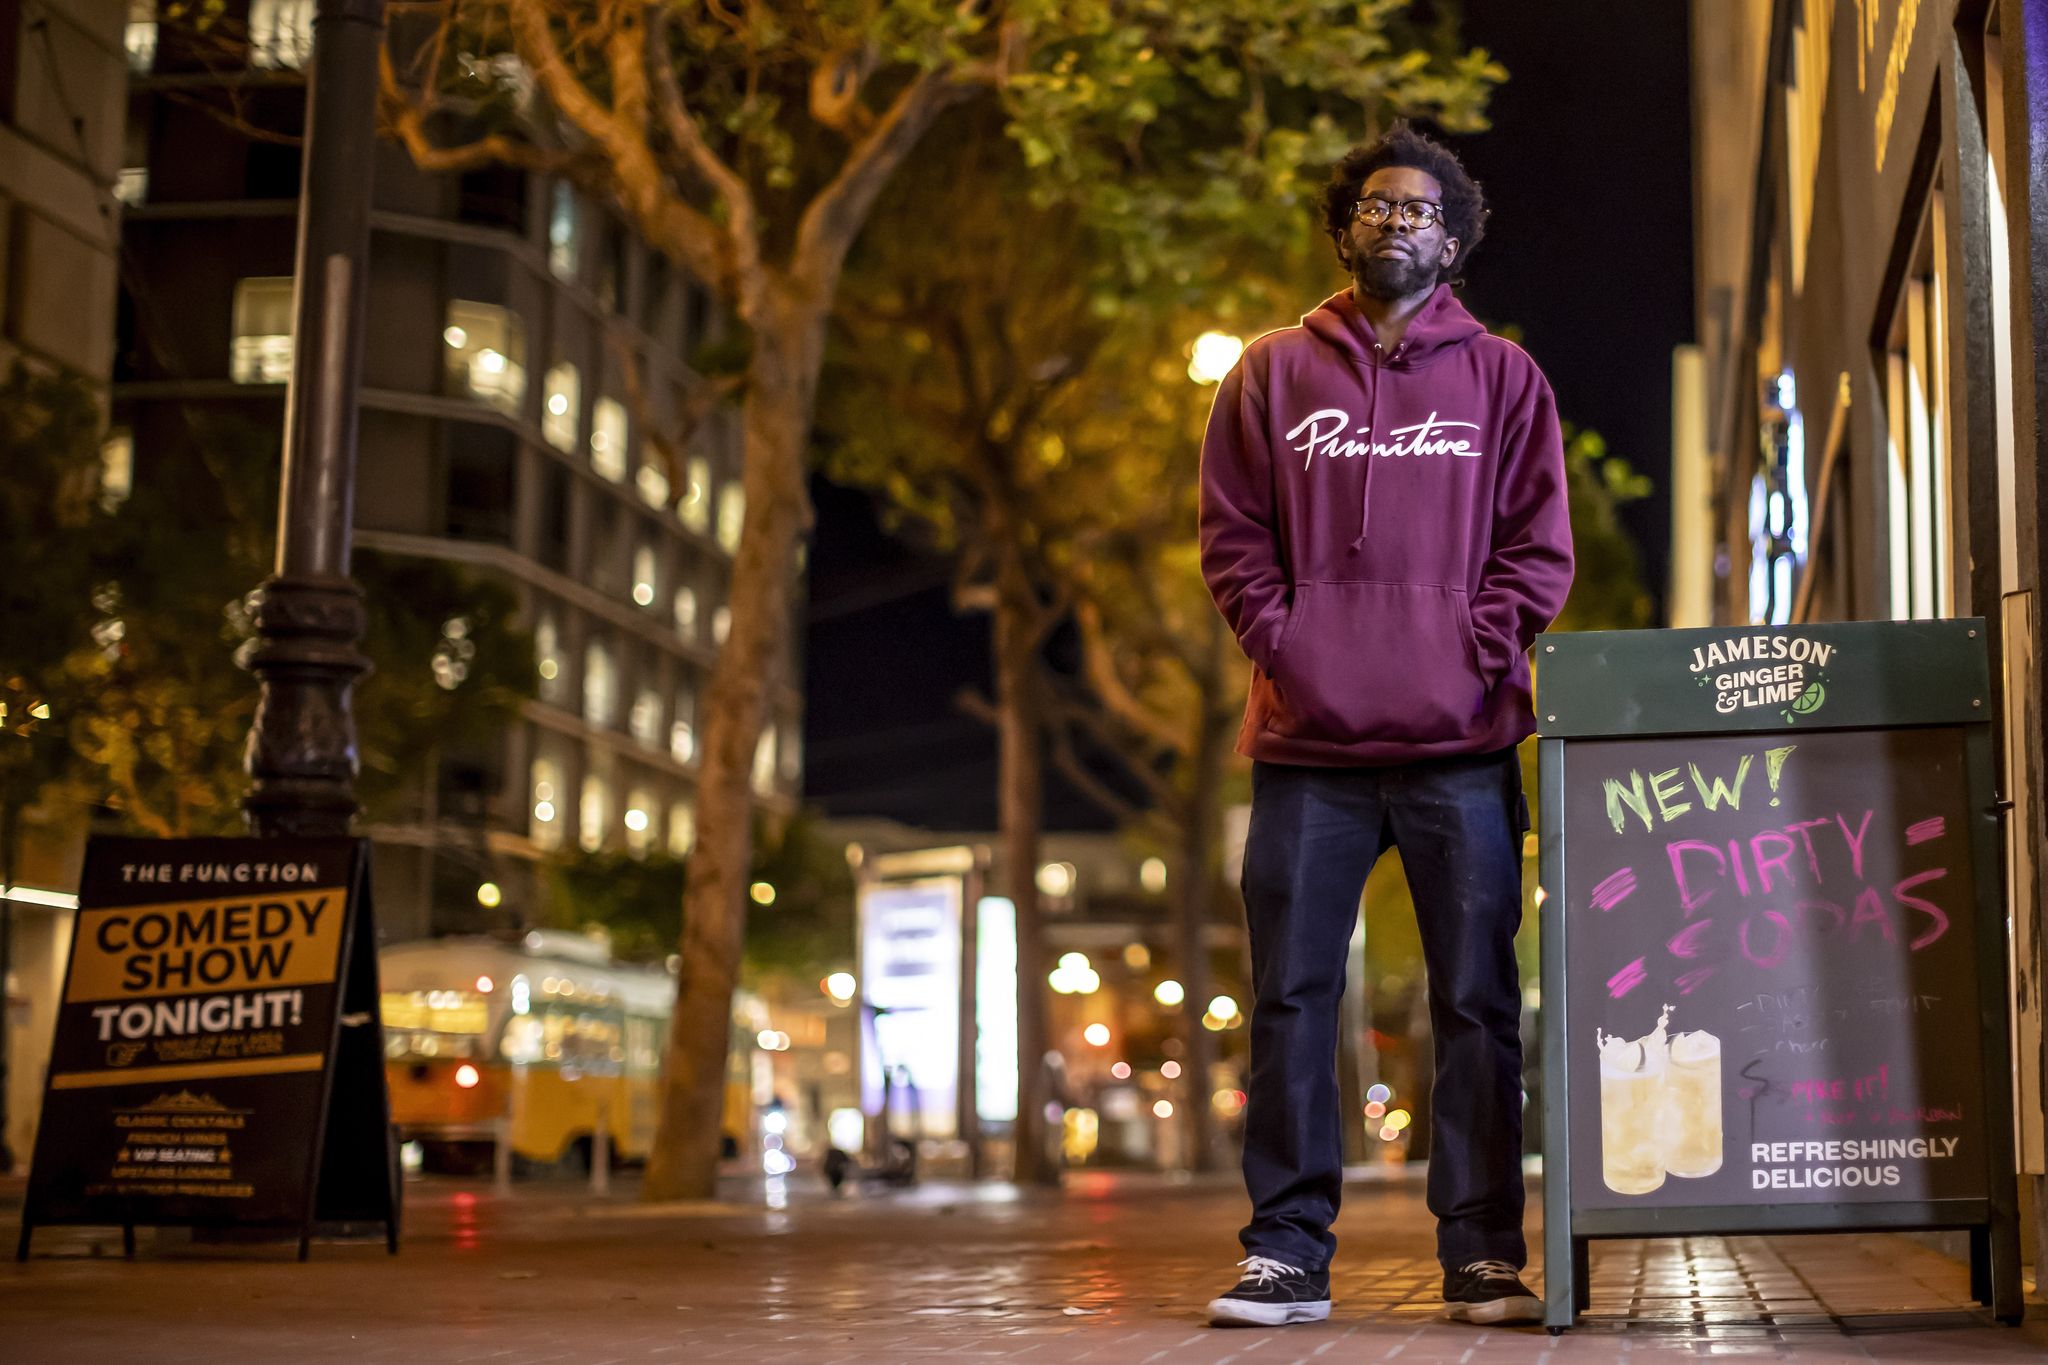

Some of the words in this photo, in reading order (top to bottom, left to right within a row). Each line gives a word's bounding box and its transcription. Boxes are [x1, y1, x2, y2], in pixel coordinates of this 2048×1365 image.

[1286, 409, 1482, 471] Primitive
[1689, 635, 1832, 673] JAMESON
[1715, 663, 1804, 691] GINGER
[1603, 745, 1797, 834] NEW!
[121, 864, 172, 883] THE
[179, 862, 319, 882] FUNCTION
[1666, 810, 1874, 917] DIRTY
[97, 897, 328, 953] COMEDY
[122, 942, 294, 991] SHOW
[91, 990, 304, 1042] TONIGHT!
[158, 1148, 217, 1163] SEATING
[1750, 1136, 1959, 1163] REFRESHINGLY
[1751, 1164, 1901, 1189] DELICIOUS
